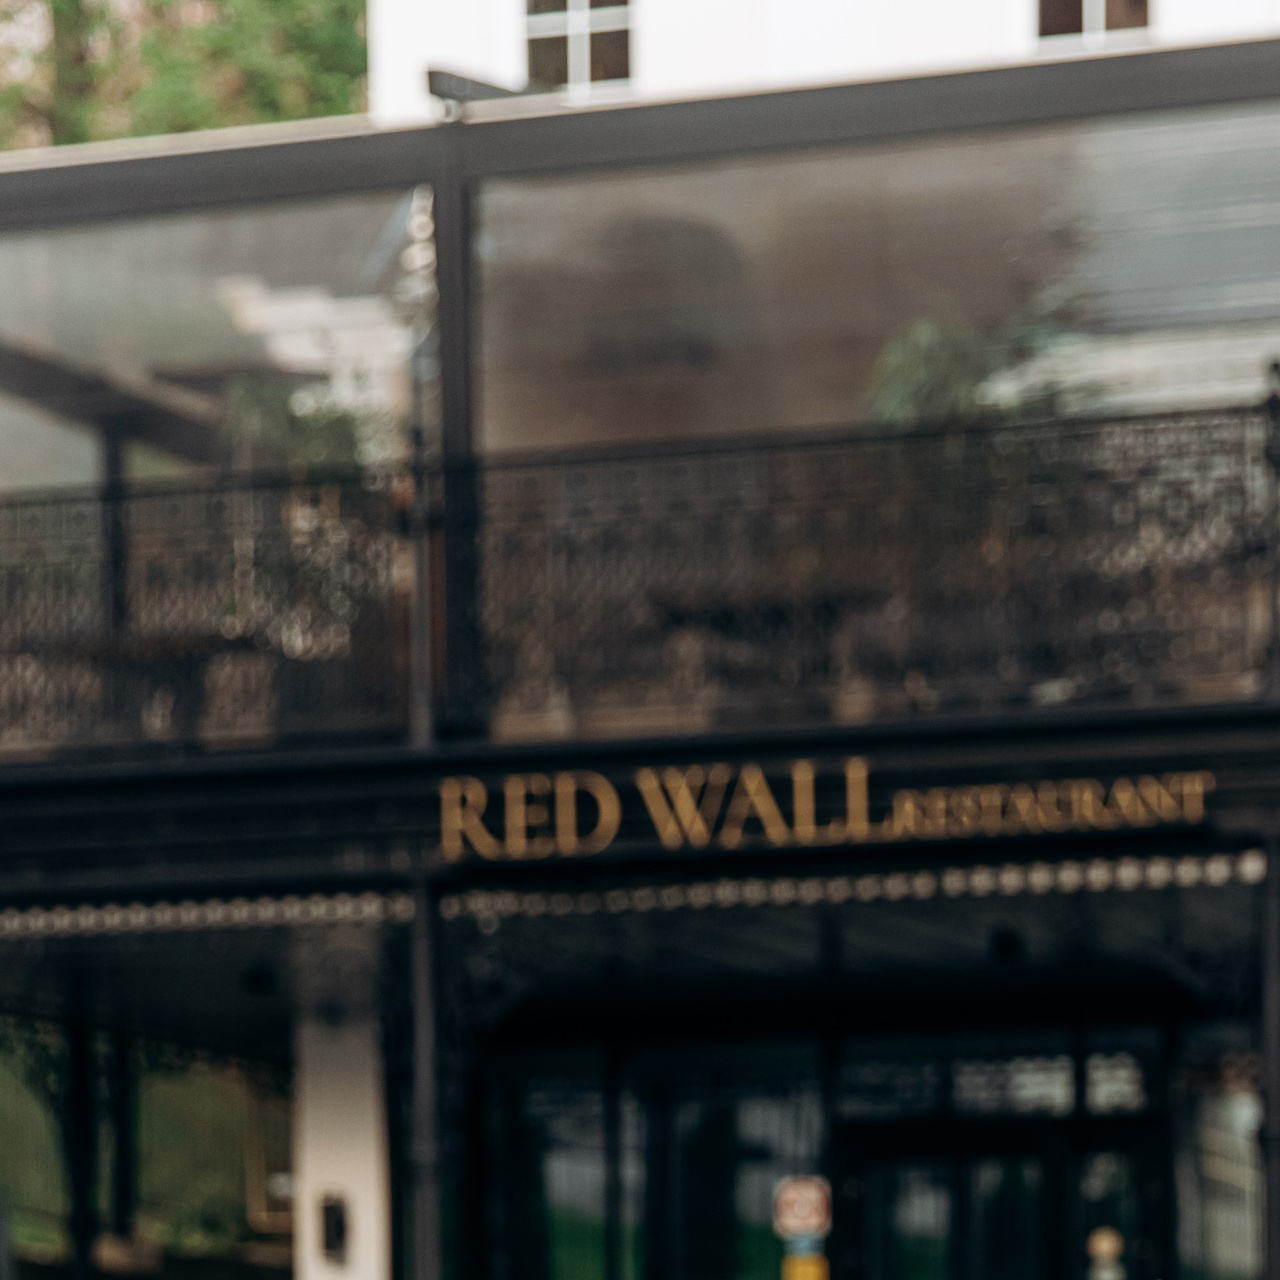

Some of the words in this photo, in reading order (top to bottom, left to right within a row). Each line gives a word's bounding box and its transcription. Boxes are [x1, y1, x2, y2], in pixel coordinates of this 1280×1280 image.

[439, 770, 622, 862] RED
[634, 756, 893, 850] WALL
[889, 771, 1216, 840] RESTAURANT
